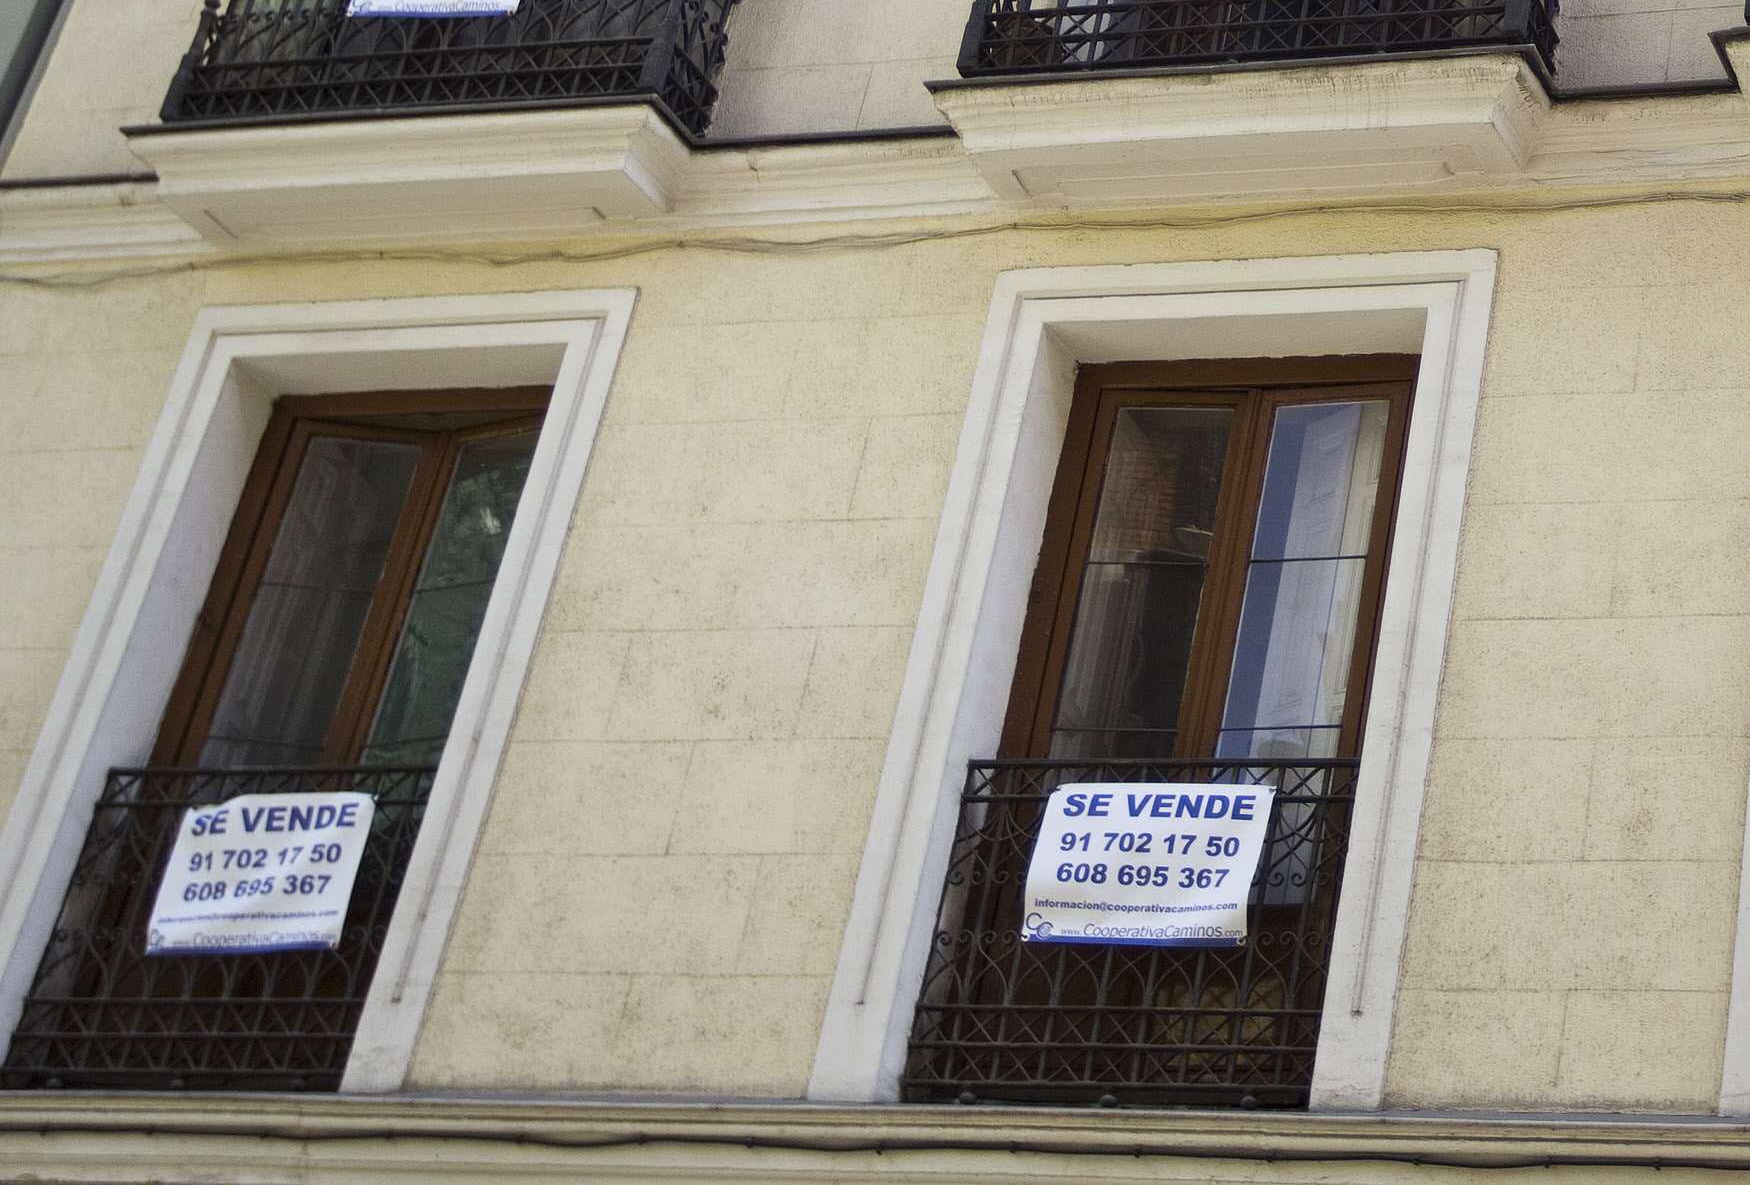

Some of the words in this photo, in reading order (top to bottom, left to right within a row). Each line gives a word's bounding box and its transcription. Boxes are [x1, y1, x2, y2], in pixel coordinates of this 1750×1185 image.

[191, 809, 230, 837] SE
[241, 802, 359, 833] VENDE
[1063, 794, 1113, 817] SE
[1127, 794, 1256, 821] VENDE
[189, 852, 213, 872] 91
[223, 849, 268, 870] 702
[277, 847, 304, 865] 17
[310, 844, 342, 863] 50
[1059, 832, 1091, 852] 91
[1103, 832, 1152, 853] 702
[1163, 834, 1196, 855] 17
[1205, 836, 1240, 857] 50
[183, 881, 226, 903] 608
[234, 876, 275, 898] 695
[283, 874, 332, 896] 367
[1056, 863, 1108, 884] 608
[1118, 865, 1169, 887] 695
[1178, 867, 1230, 888] 367
[1035, 898, 1238, 913] informacion@cooperativacaminos.com
